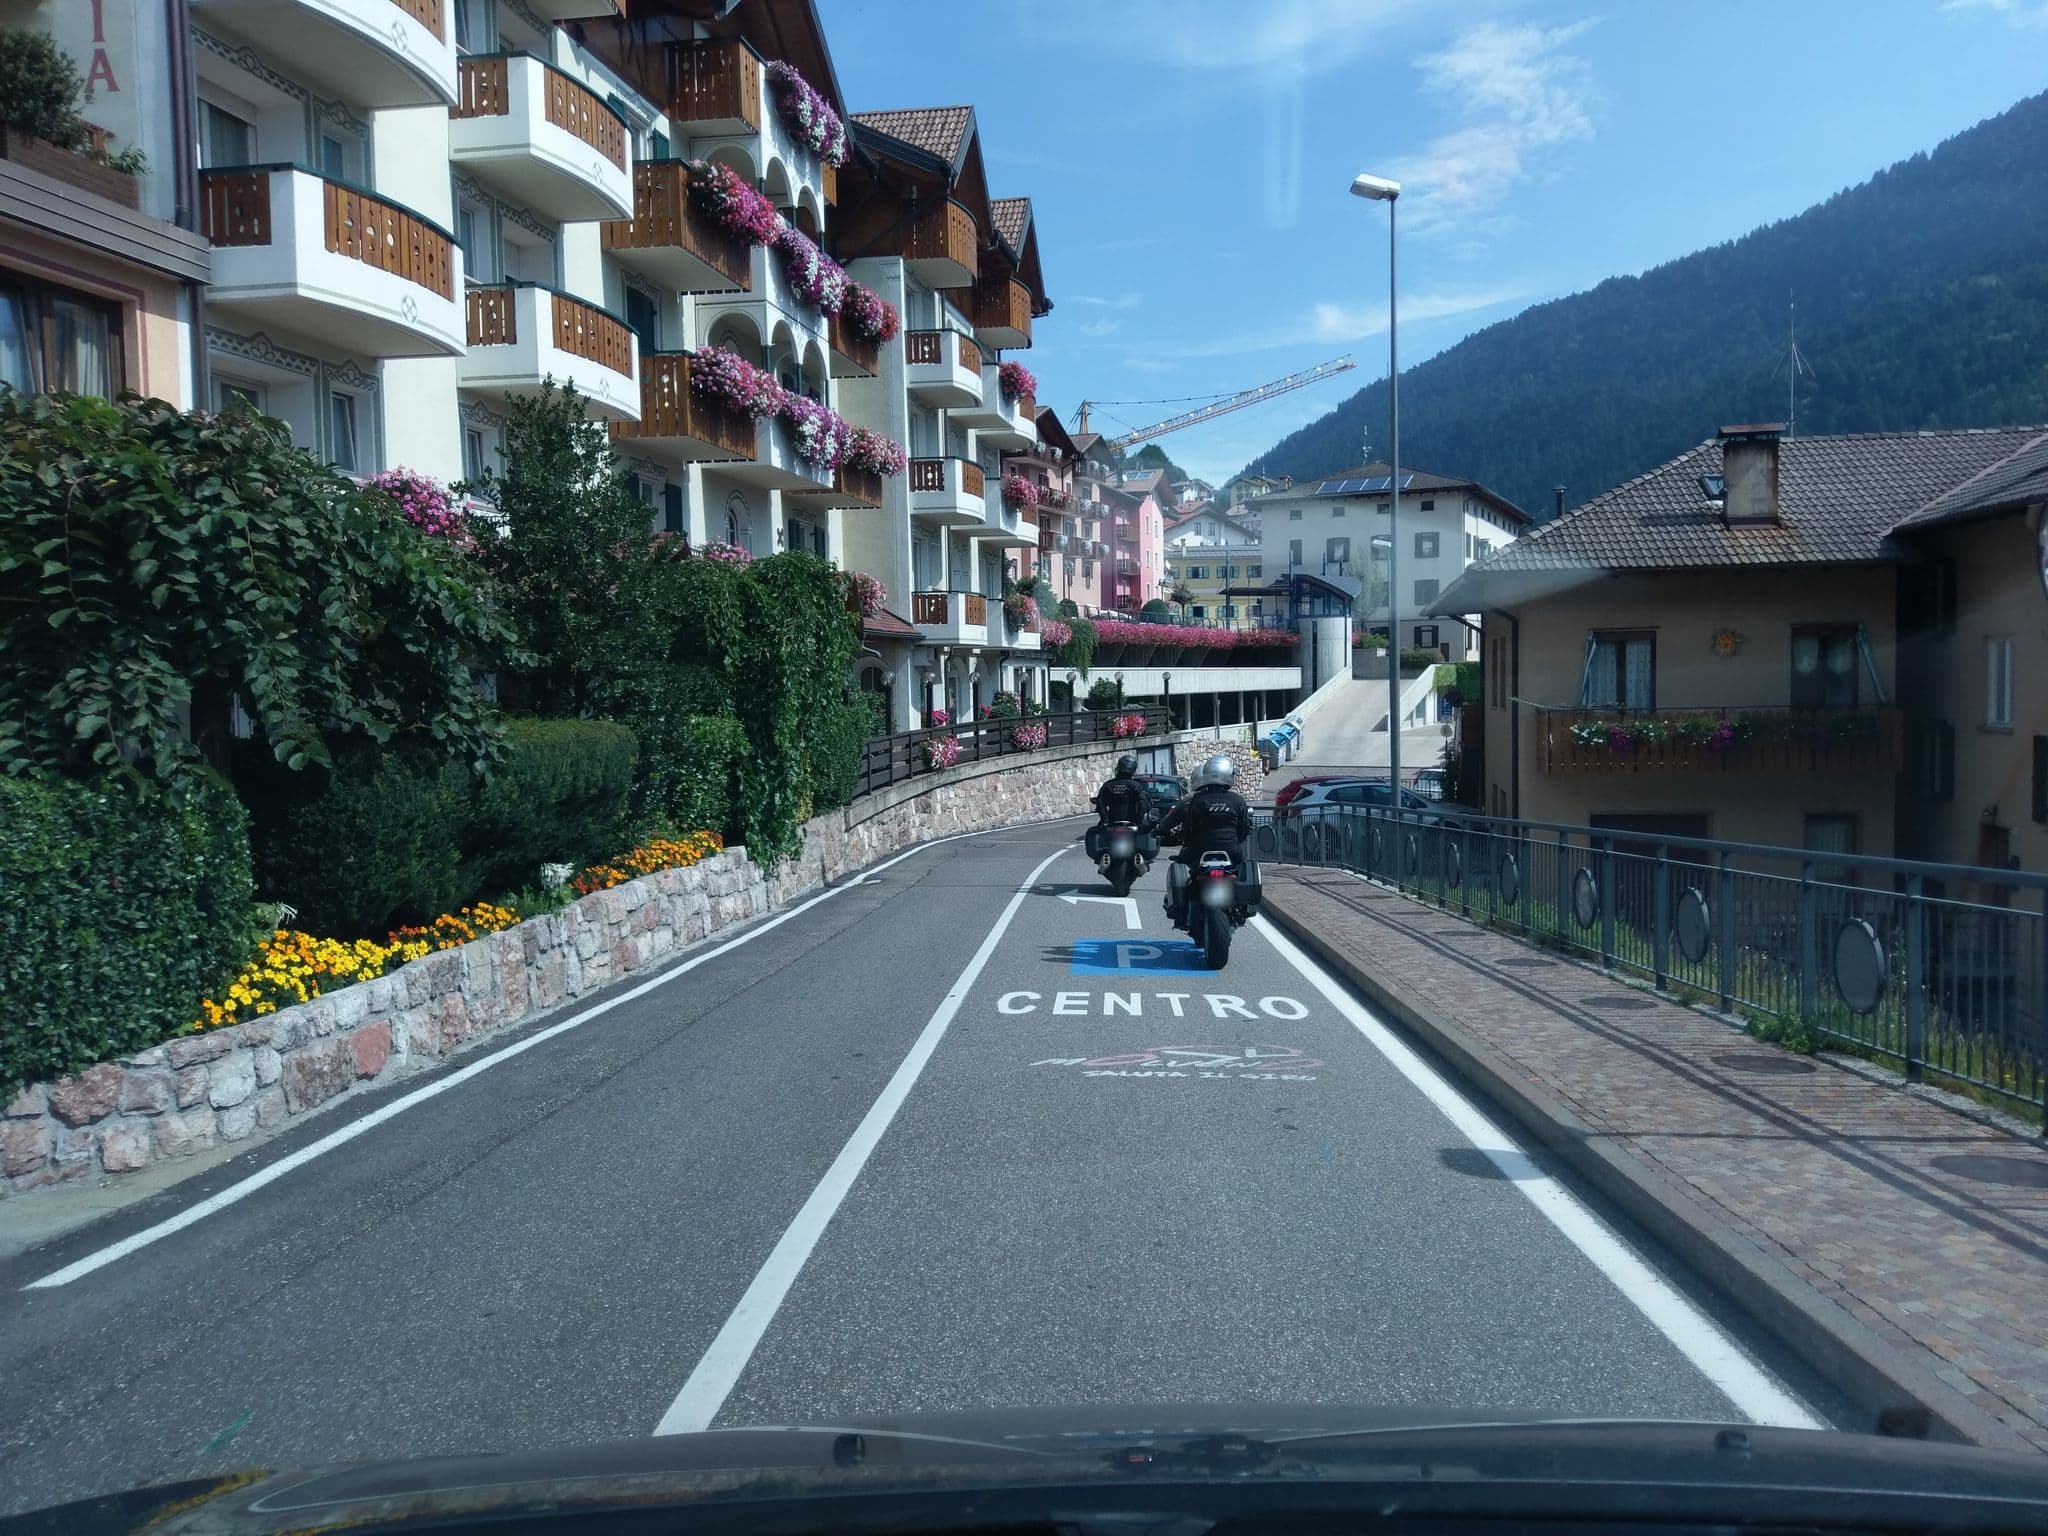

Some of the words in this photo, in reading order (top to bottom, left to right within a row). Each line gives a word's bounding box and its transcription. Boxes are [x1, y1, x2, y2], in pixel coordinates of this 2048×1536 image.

[1116, 944, 1163, 969] P
[996, 991, 1309, 1020] CENTRO
[1082, 1070, 1188, 1078] SALUTA
